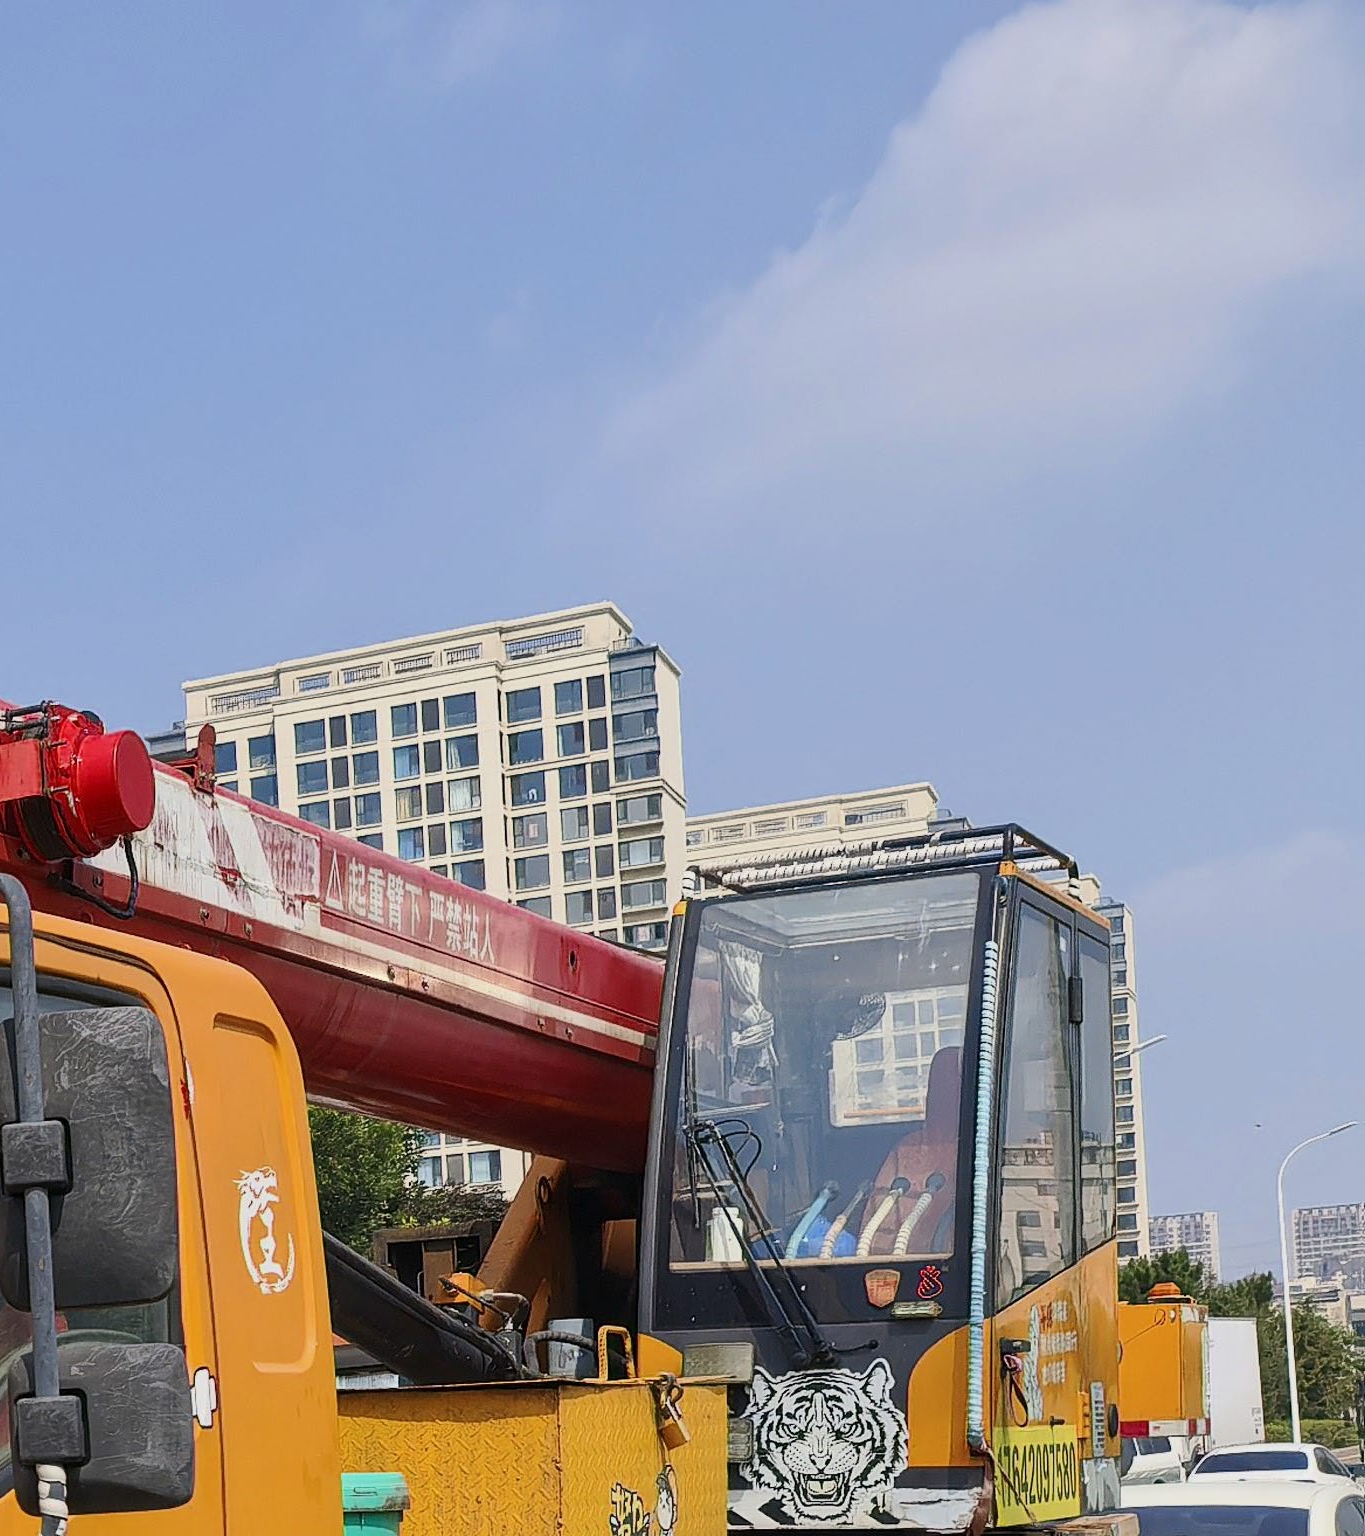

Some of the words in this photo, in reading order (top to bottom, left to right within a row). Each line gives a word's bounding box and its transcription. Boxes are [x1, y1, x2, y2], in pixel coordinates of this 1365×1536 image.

[348, 856, 424, 936] 起重臂下
[428, 890, 496, 964] 严禁站人
